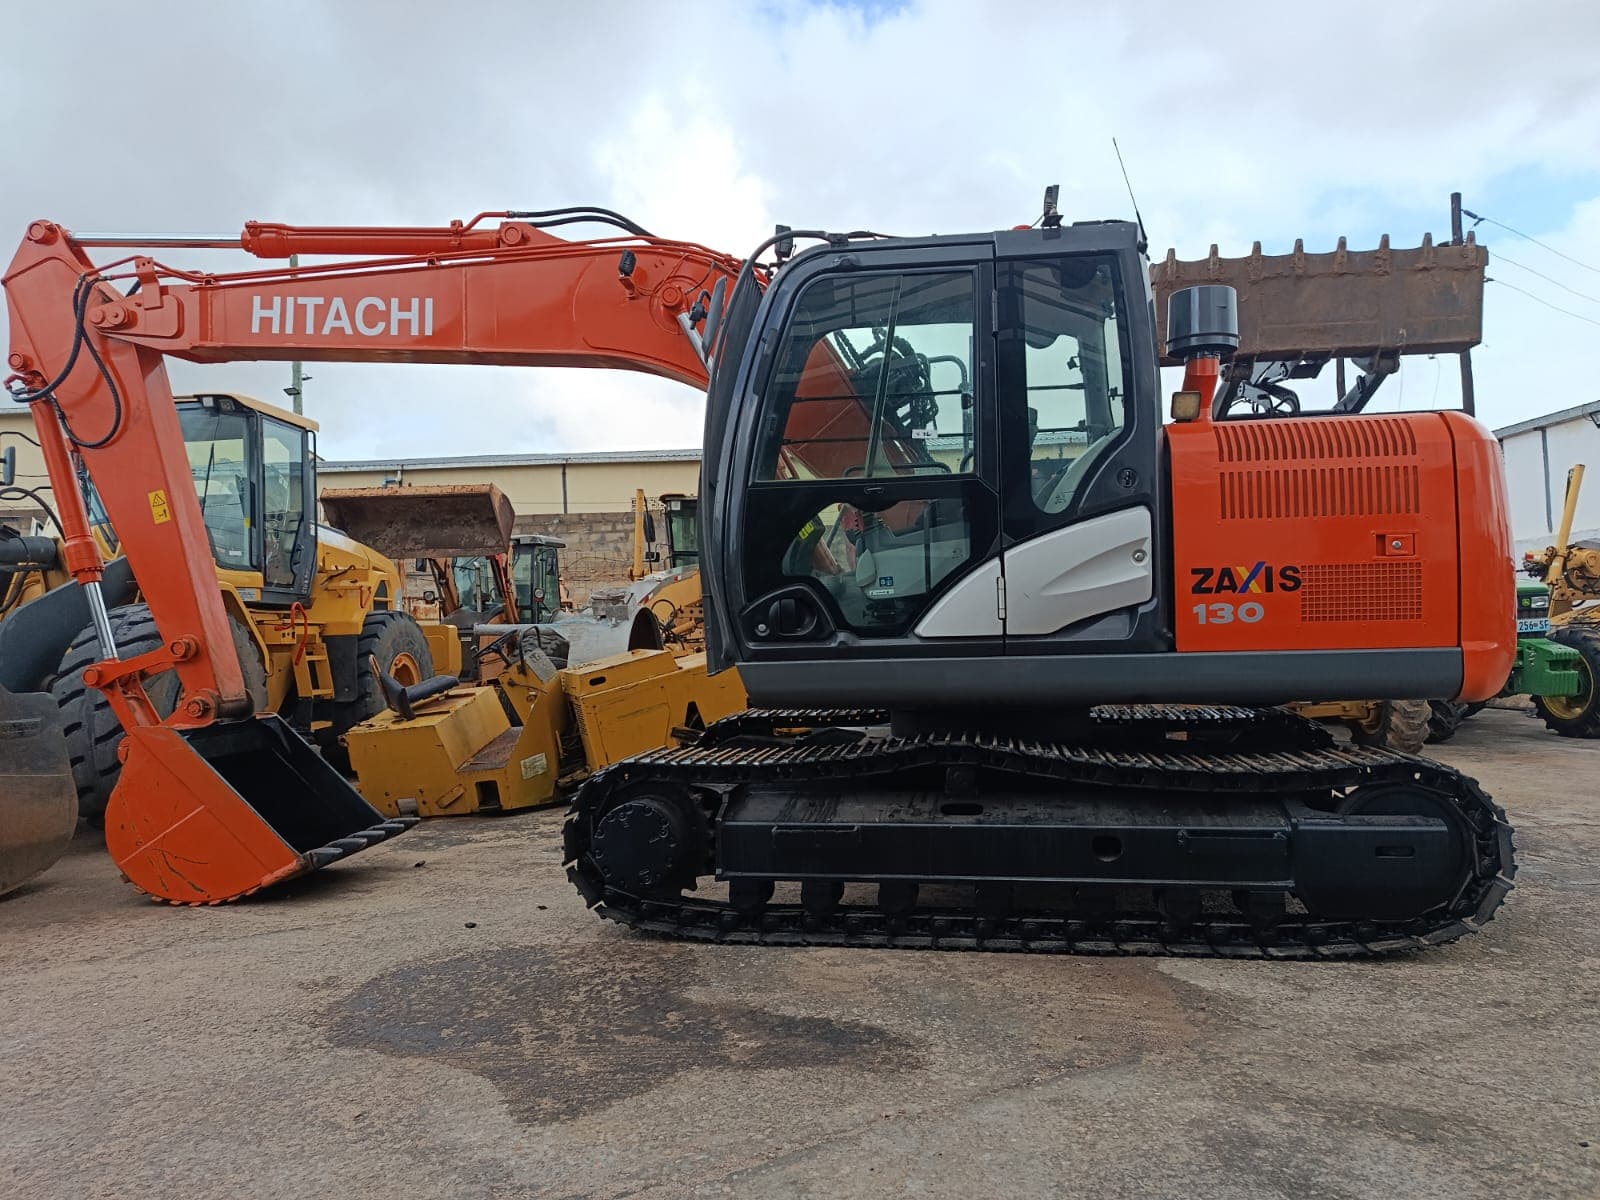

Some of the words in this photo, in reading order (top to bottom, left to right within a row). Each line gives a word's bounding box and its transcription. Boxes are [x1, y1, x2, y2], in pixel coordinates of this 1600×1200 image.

[251, 295, 434, 337] HITACHI
[1190, 561, 1303, 595] ZAXIS
[1192, 602, 1265, 625] 130
[1518, 620, 1534, 631] 256
